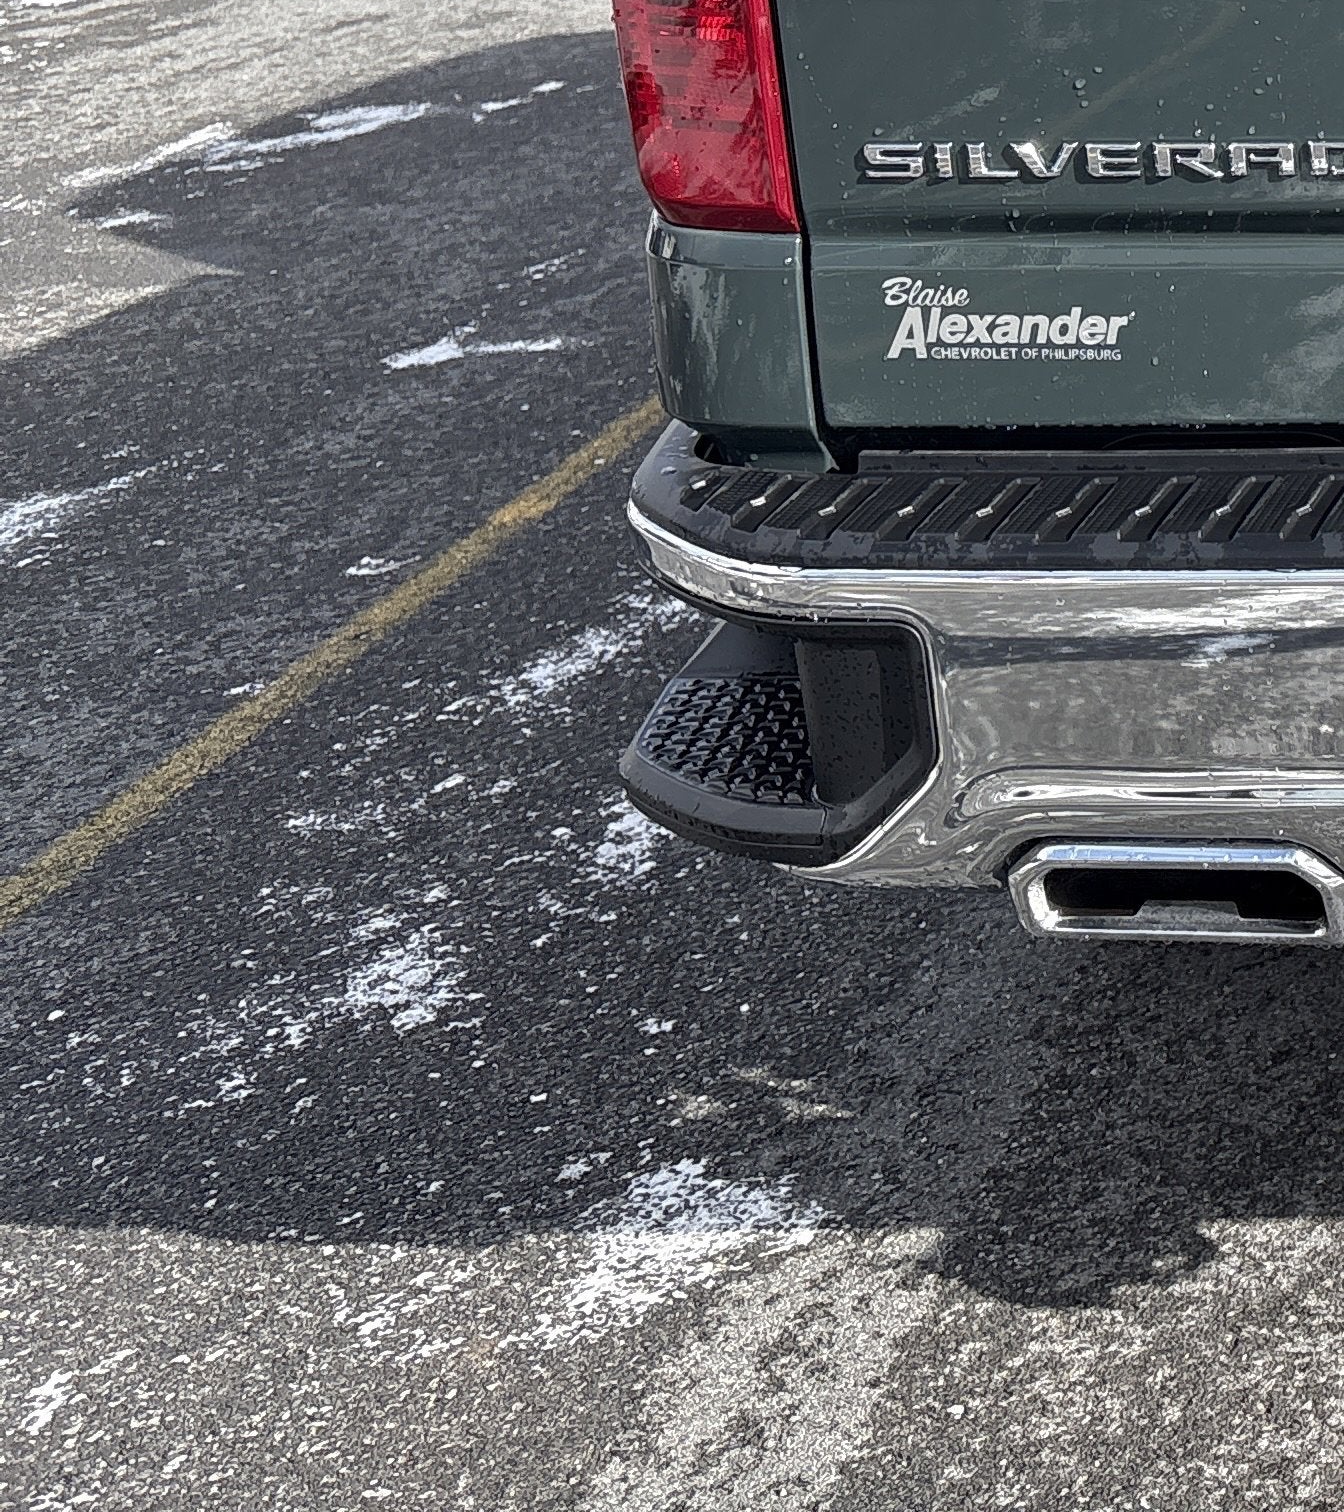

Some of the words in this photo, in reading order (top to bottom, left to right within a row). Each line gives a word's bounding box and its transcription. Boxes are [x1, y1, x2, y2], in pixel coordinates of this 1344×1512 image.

[881, 276, 971, 307] Blaise
[886, 306, 1130, 359] Alexander
[930, 346, 1019, 361] CHEVROLET
[1021, 347, 1040, 361] OF
[1041, 347, 1122, 361] PHILIPSBURG
